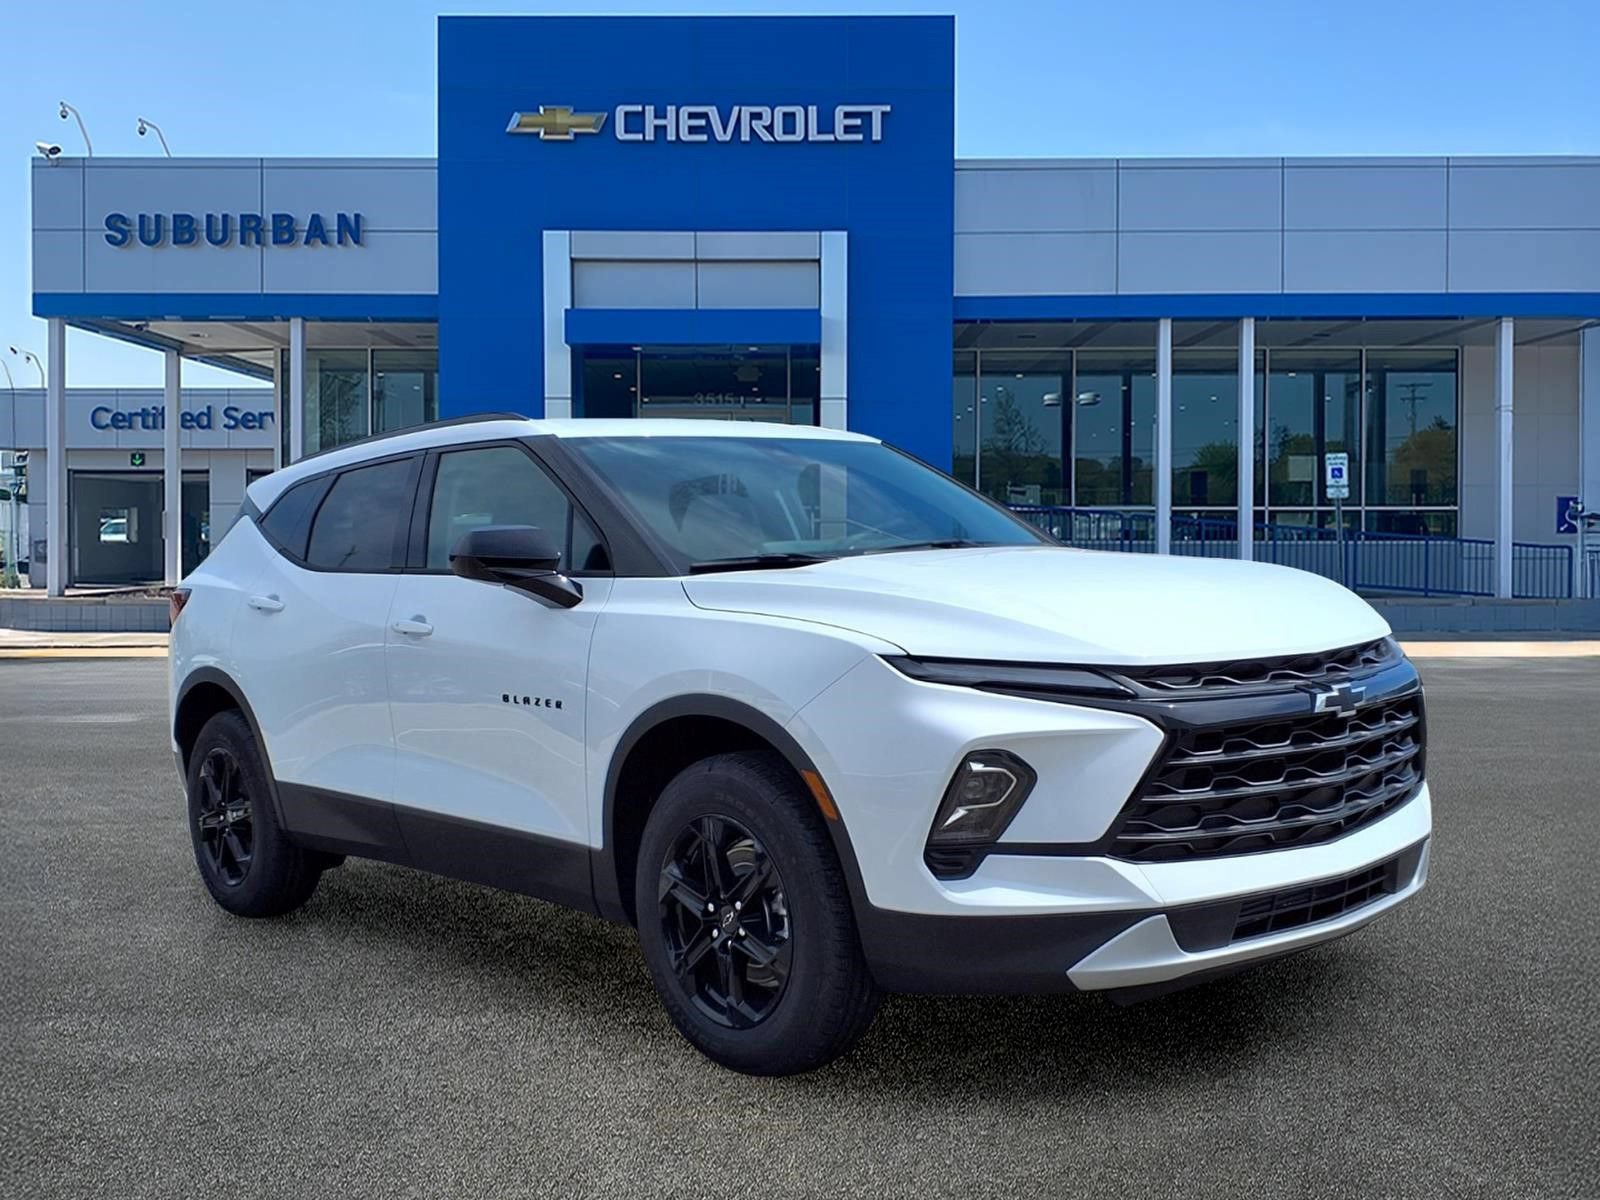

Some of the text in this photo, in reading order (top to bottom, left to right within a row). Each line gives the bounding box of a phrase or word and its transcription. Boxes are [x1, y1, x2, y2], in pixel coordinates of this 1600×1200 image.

[614, 104, 892, 143] CHEVROLET
[104, 212, 362, 247] SUBURBAN
[90, 406, 212, 431] Certifed
[502, 693, 563, 710] BLAZER
